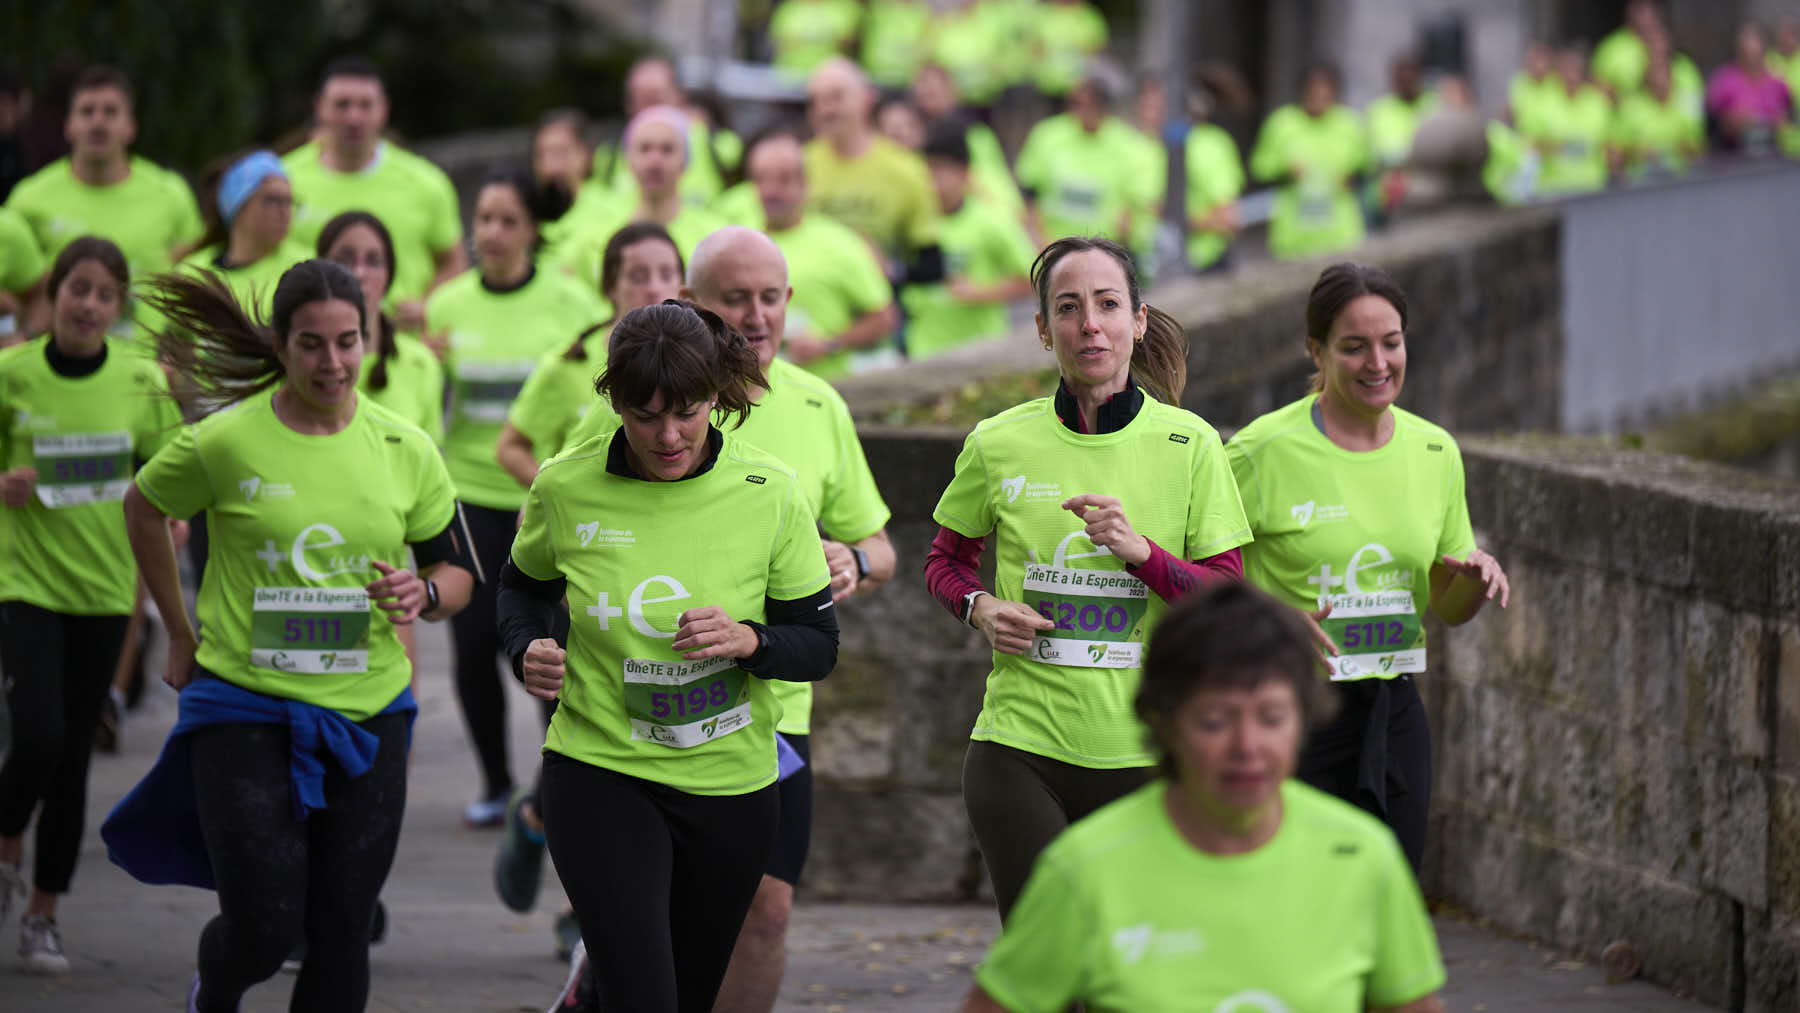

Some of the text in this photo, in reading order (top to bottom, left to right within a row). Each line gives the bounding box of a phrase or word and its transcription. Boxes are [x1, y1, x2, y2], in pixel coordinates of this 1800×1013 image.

[1061, 574, 1069, 585] a
[1071, 572, 1083, 585] la
[1086, 573, 1145, 589] Esperanza
[283, 617, 343, 643] 5111
[1039, 600, 1128, 633] 5200
[1343, 620, 1404, 648] 5112
[666, 666, 673, 676] a
[677, 664, 687, 676] la
[651, 680, 728, 718] 5198
